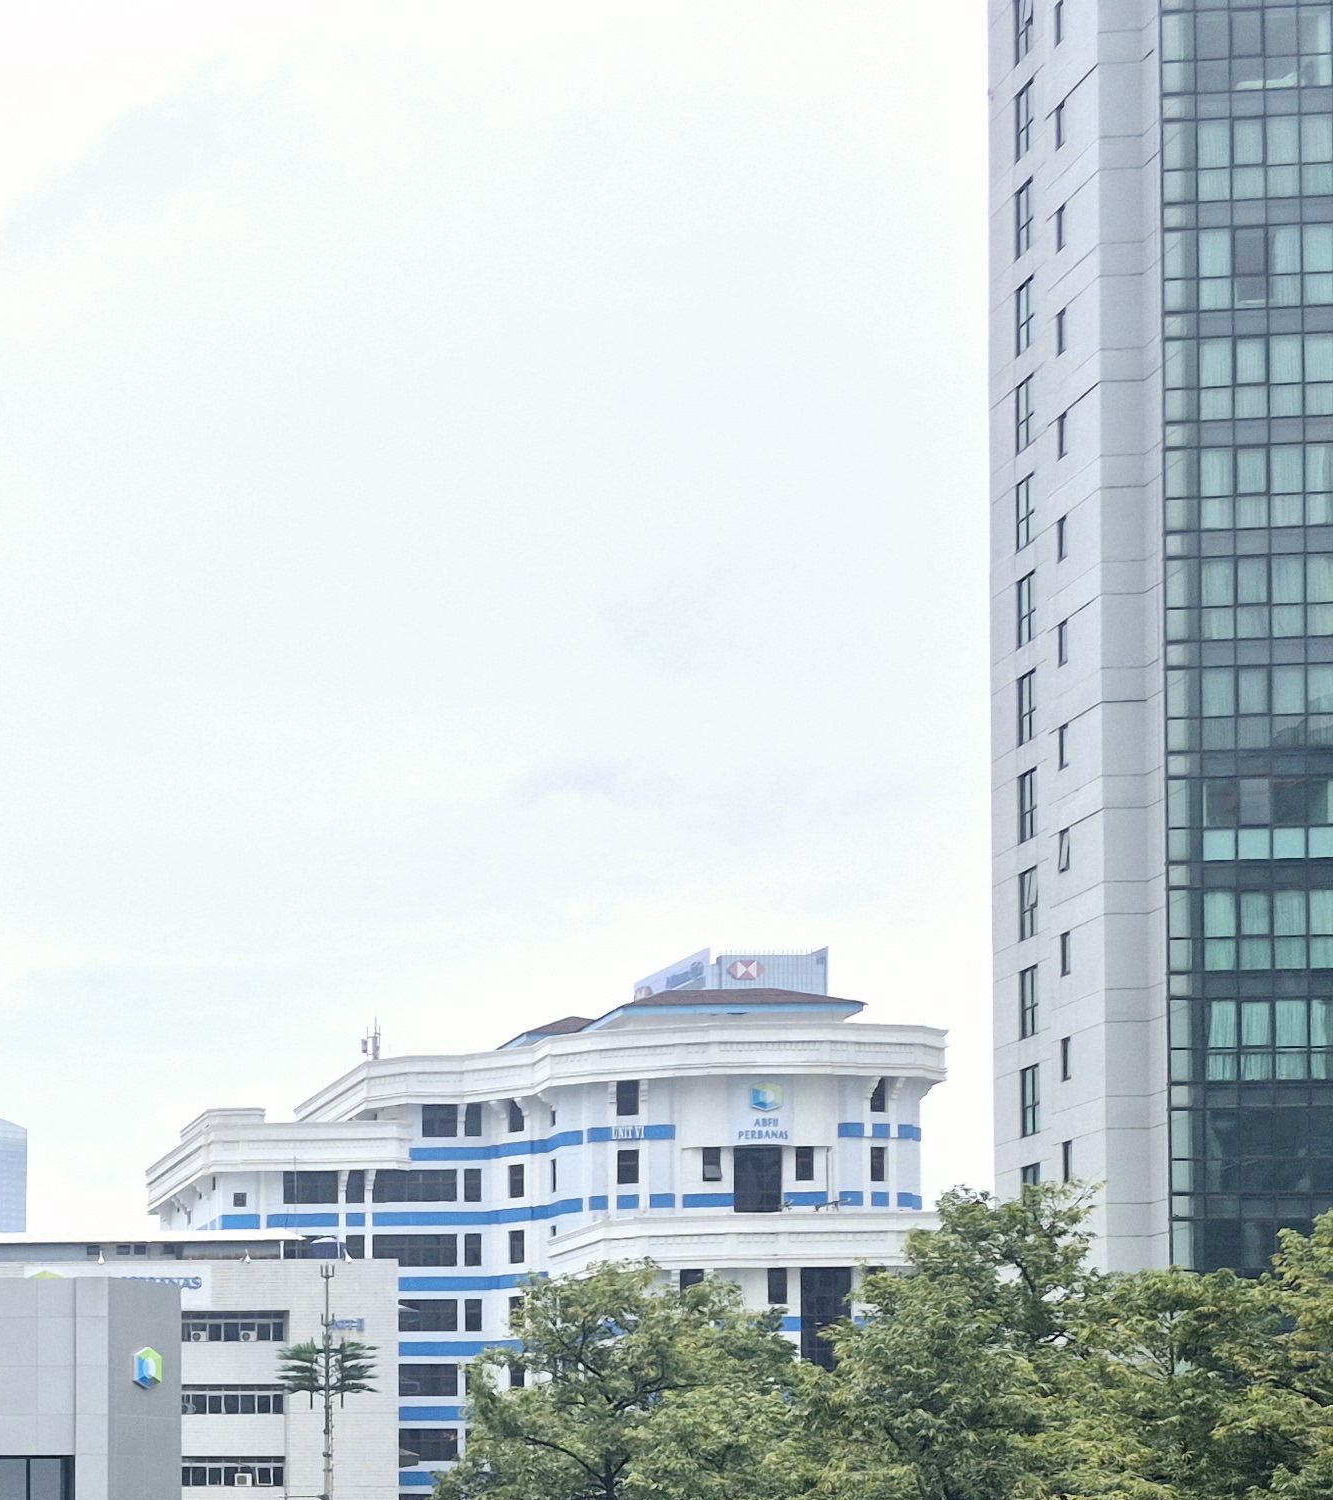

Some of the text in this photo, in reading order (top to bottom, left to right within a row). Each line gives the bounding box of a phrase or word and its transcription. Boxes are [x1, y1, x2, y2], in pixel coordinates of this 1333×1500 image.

[754, 1117, 779, 1127] ABFII
[612, 1125, 633, 1140] UNIT
[738, 1130, 789, 1140] PERBANAS
